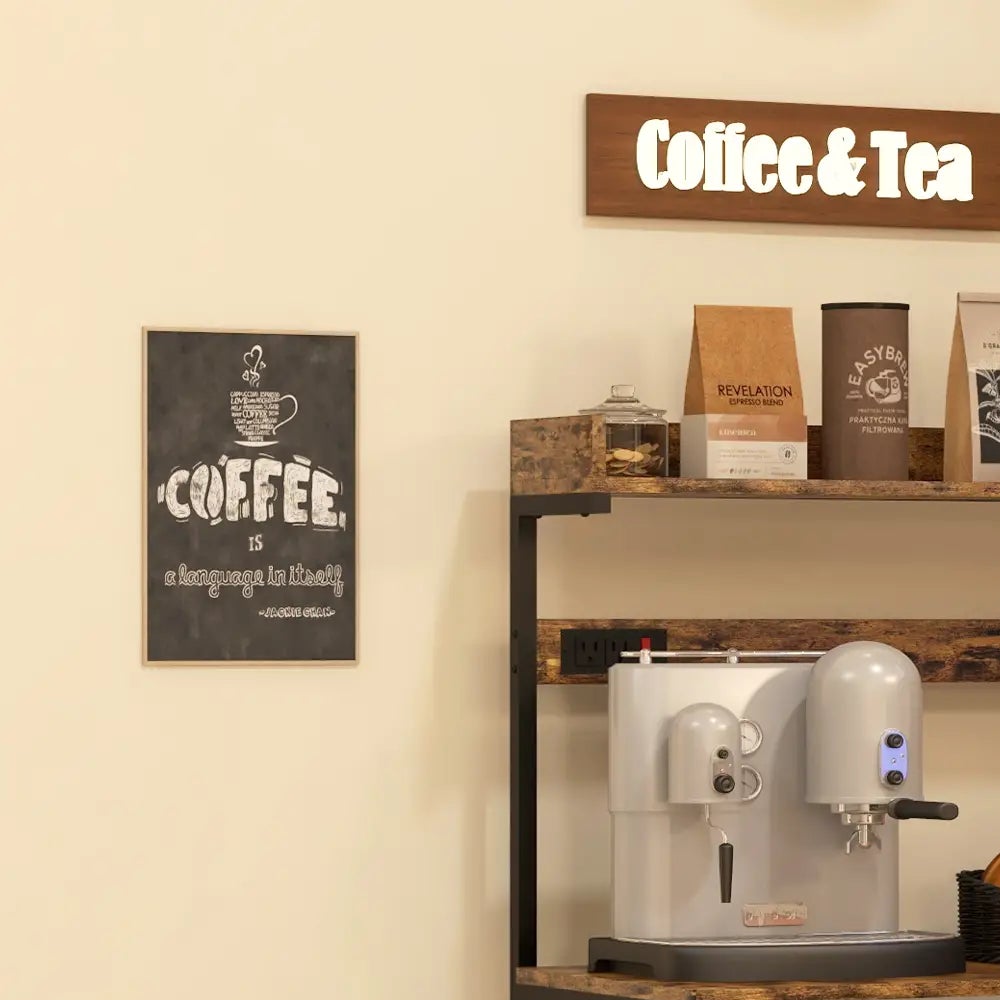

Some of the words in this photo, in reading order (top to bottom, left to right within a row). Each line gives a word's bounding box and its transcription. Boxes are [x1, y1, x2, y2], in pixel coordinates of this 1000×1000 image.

[717, 384, 793, 397] REVELATION
[729, 397, 761, 406] ESPRESSO
[763, 398, 784, 406] BLEND
[164, 458, 340, 527] COFFEE
[248, 534, 263, 551] IS
[164, 570, 176, 586] a
[178, 563, 265, 598] language
[267, 565, 287, 587] in
[288, 562, 345, 598] itself
